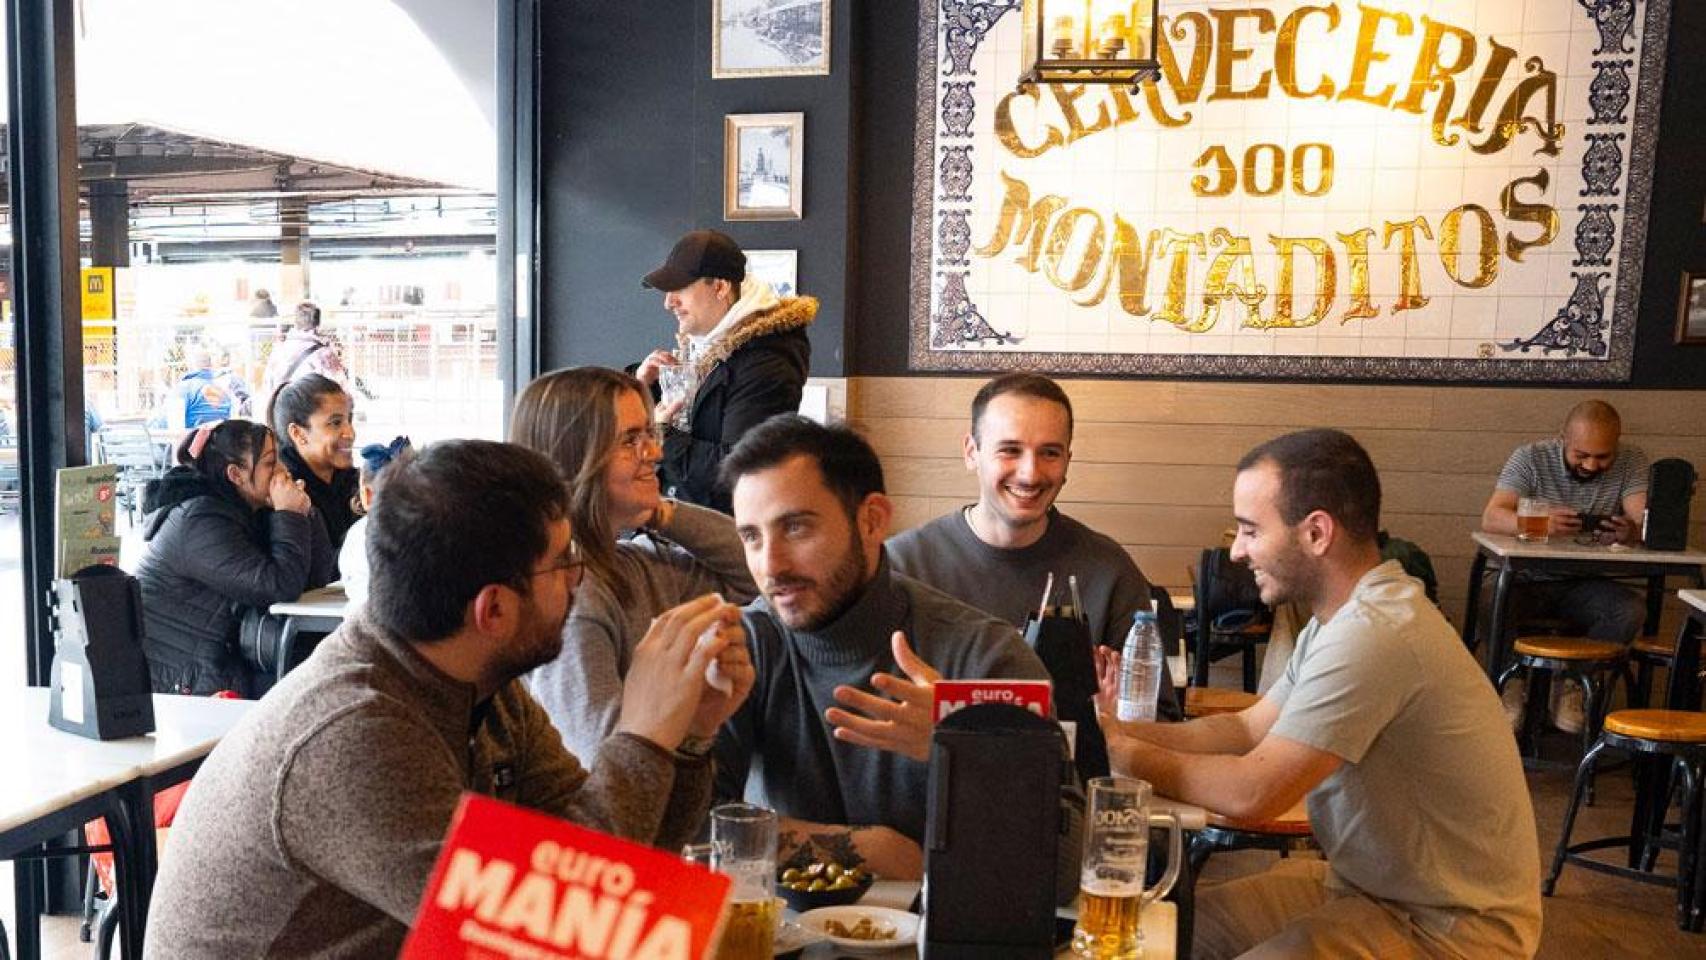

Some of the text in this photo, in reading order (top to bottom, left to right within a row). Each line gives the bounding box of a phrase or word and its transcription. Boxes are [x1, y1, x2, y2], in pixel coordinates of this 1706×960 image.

[1191, 143, 1334, 198] 100
[973, 168, 1560, 333] MONTADITOS
[972, 689, 1014, 701] euro
[531, 840, 637, 896] euro
[436, 848, 694, 960] MANÍA
